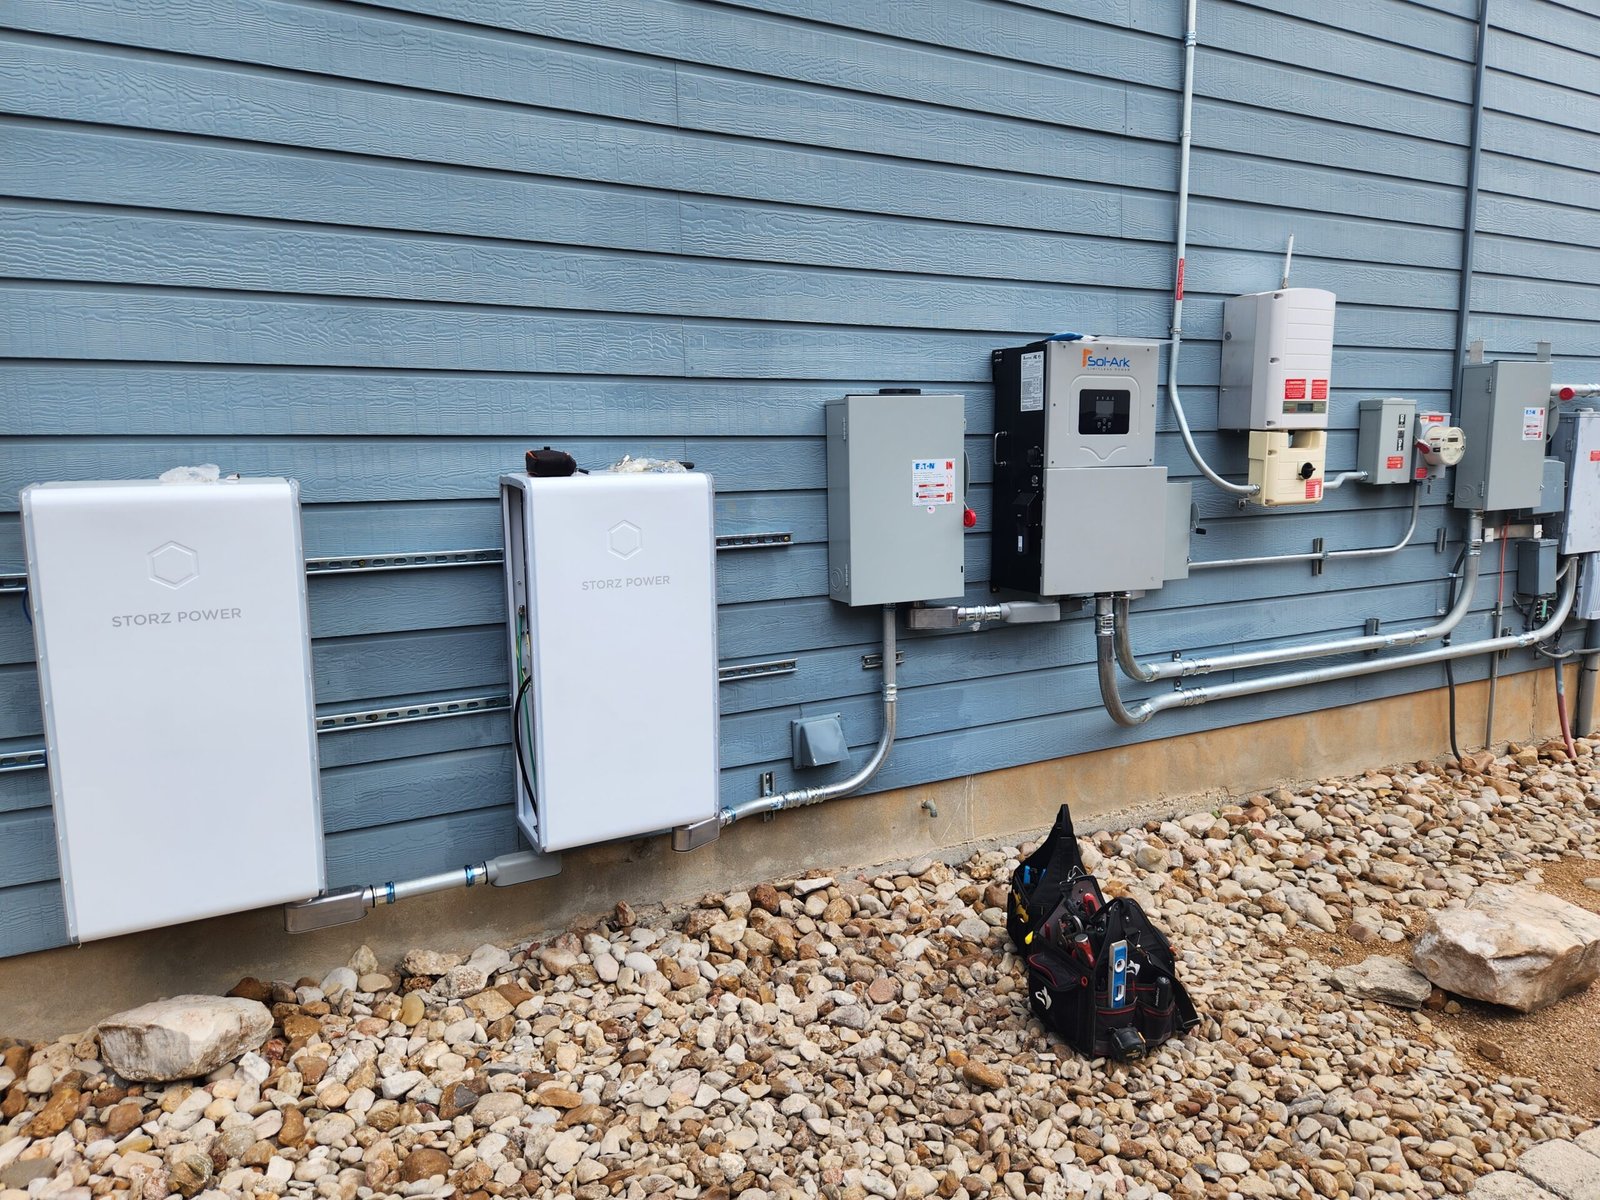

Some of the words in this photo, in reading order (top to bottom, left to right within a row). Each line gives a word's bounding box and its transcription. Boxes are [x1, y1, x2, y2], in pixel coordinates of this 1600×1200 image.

[1087, 356, 1130, 368] Sol-Ark
[946, 461, 953, 470] ON
[945, 492, 953, 502] OFF
[581, 579, 623, 591] STORZ
[625, 575, 671, 588] POWER
[112, 613, 172, 627] STORZ
[178, 608, 242, 622] POWER
